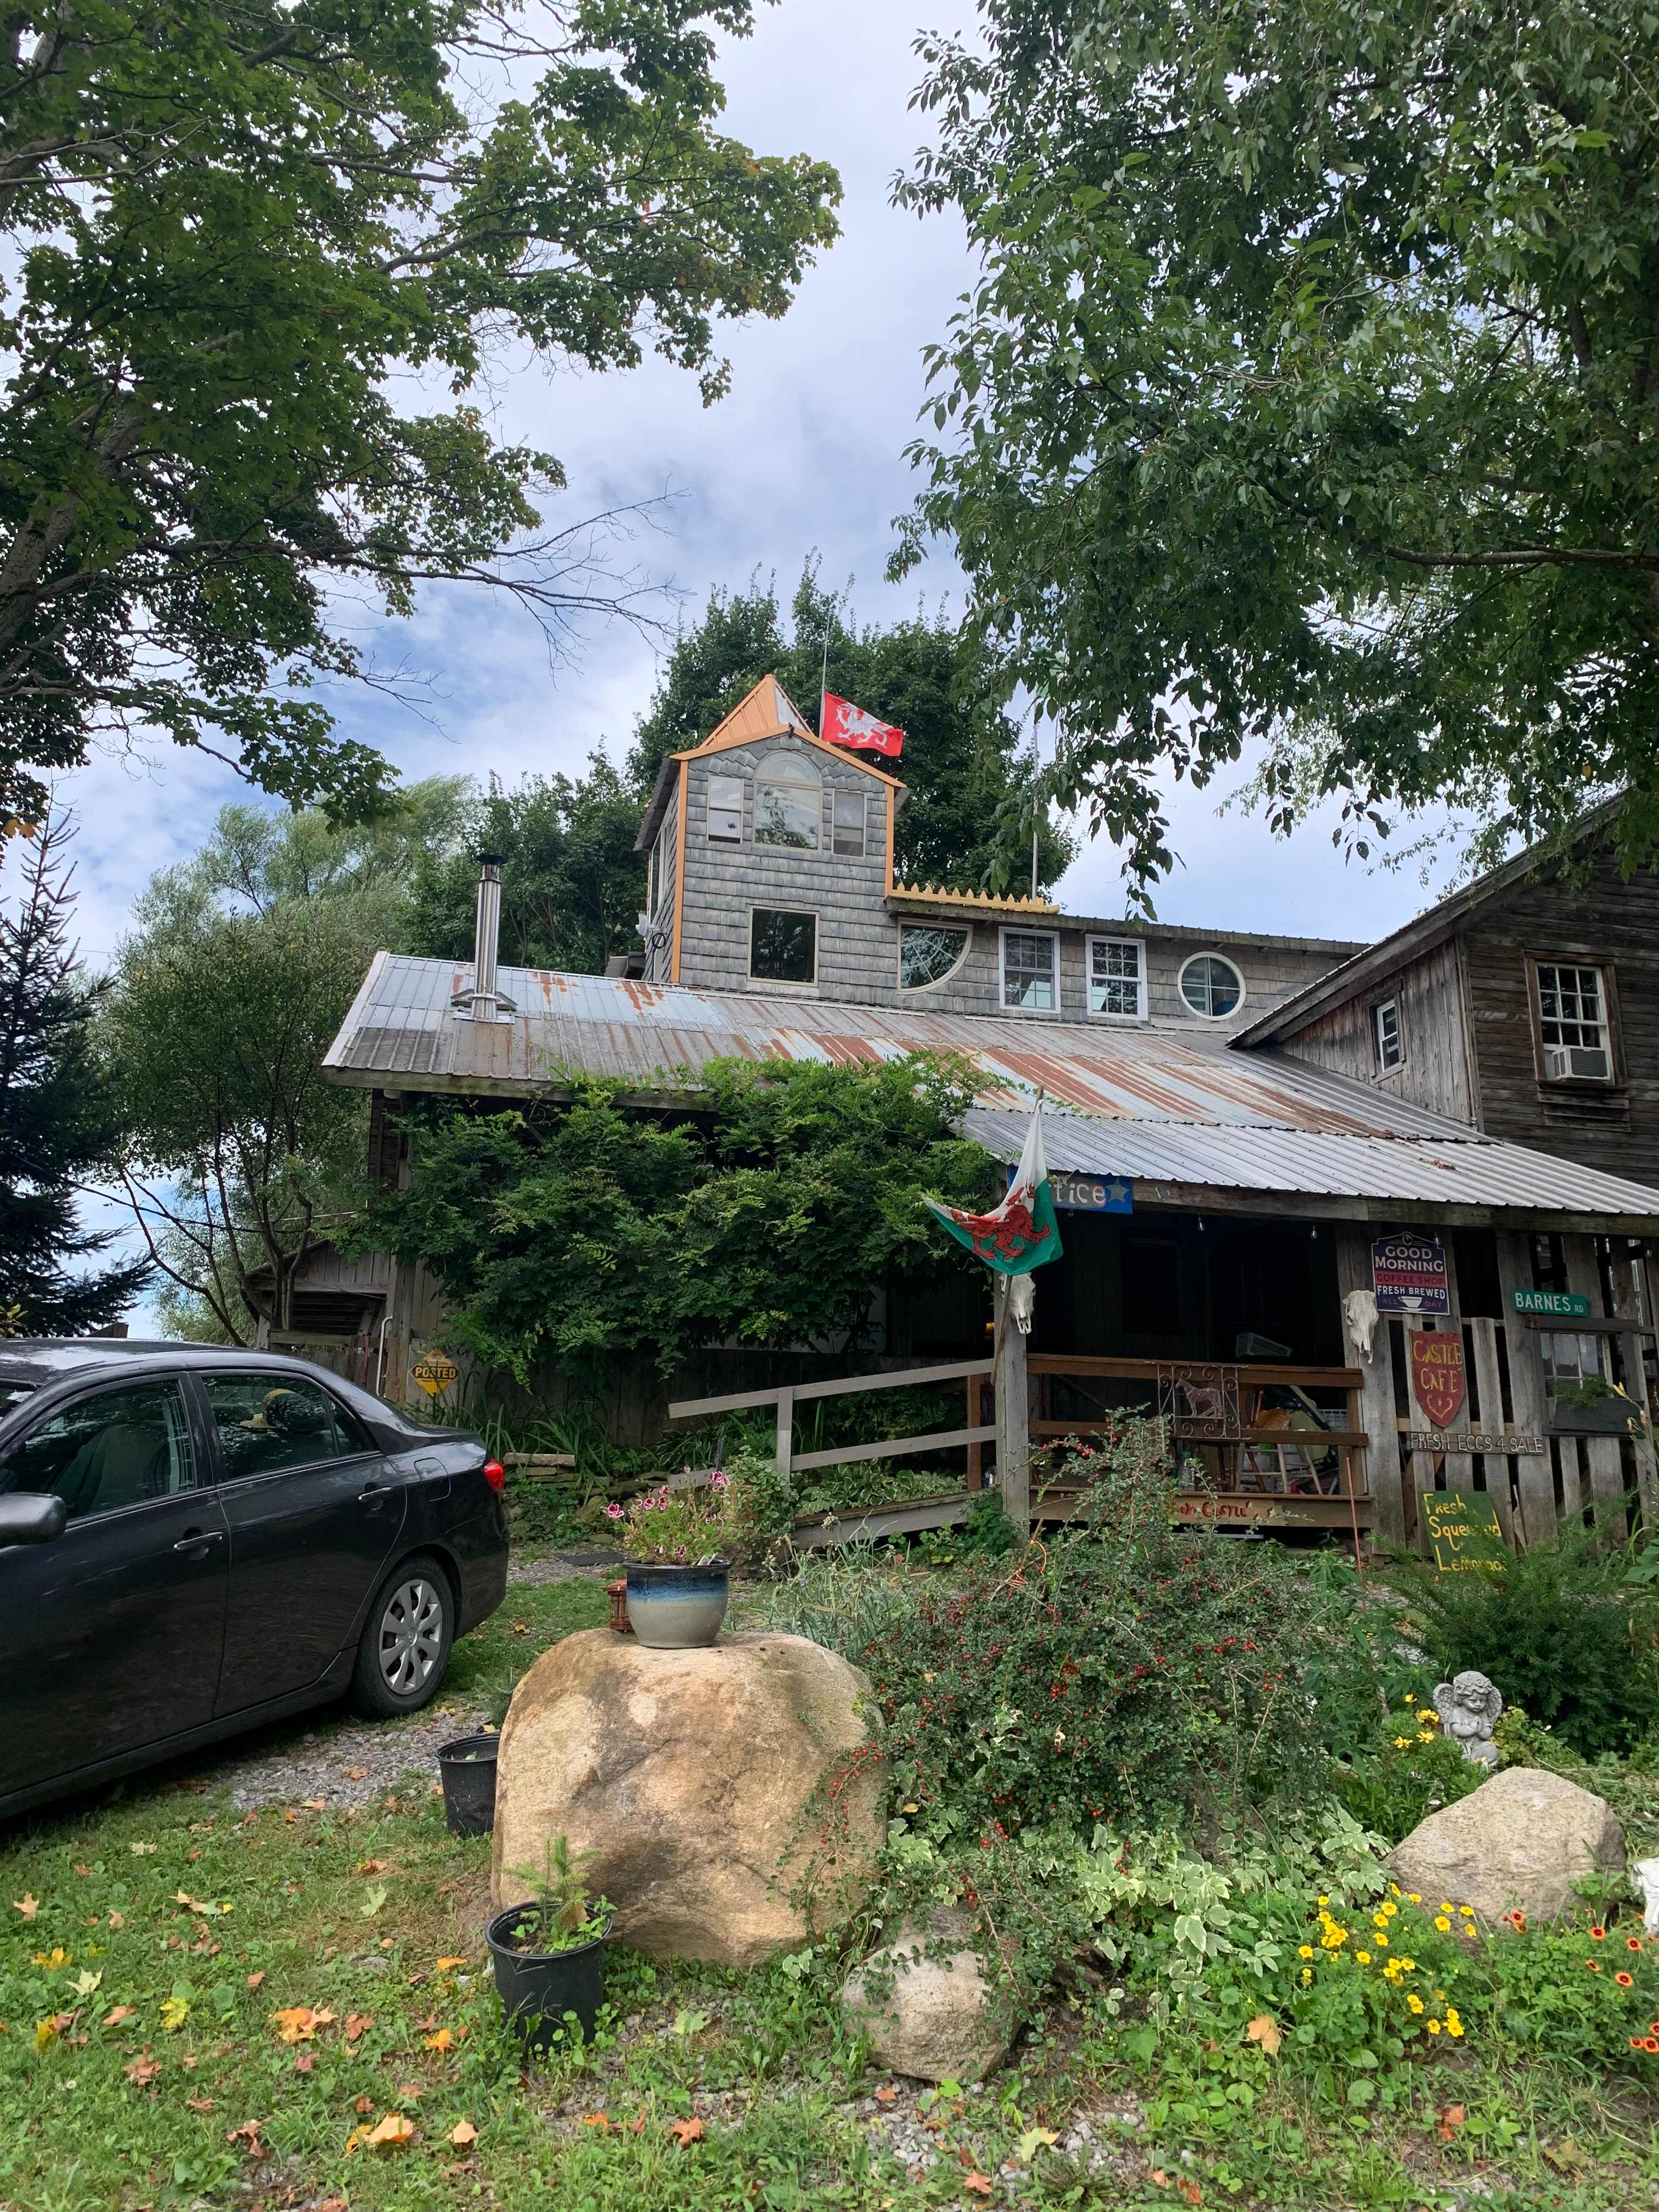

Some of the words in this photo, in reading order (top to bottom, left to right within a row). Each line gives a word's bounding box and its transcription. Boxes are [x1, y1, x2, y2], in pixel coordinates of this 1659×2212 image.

[1385, 1246, 1432, 1259] GOOD
[1374, 1256, 1444, 1272] MORNING
[1376, 1274, 1414, 1284] COFFEE
[1418, 1276, 1444, 1285] SHOP
[1377, 1285, 1405, 1296] FRESH
[1409, 1288, 1445, 1299] BREWED
[1515, 1292, 1571, 1312] BARNES
[1575, 1305, 1584, 1313] RD
[415, 1367, 456, 1379] POSTED
[1410, 1433, 1450, 1450] FRESH
[1458, 1435, 1492, 1451] EGGS
[1496, 1437, 1506, 1453] 4
[1509, 1437, 1543, 1453] SALE
